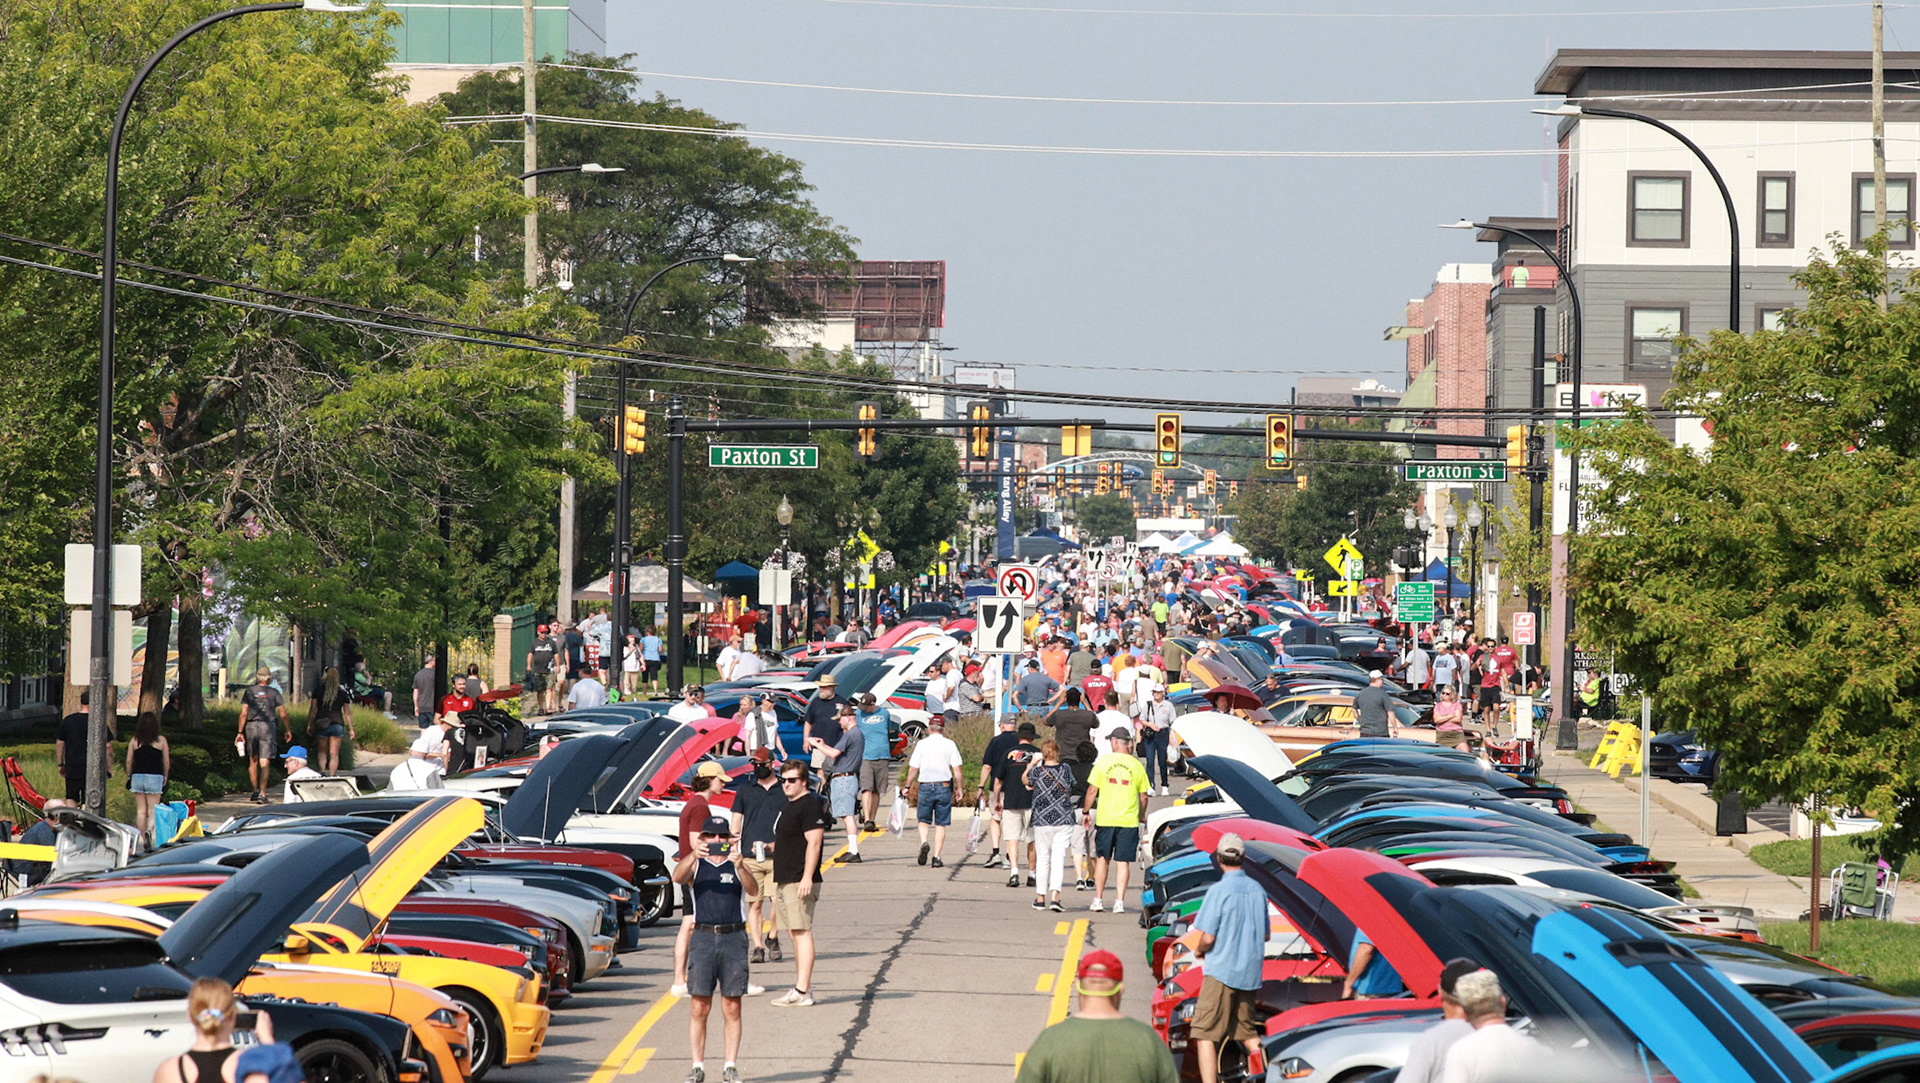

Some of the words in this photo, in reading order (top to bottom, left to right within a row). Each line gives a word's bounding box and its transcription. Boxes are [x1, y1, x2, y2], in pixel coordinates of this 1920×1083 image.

[721, 448, 781, 465] Paxton
[789, 448, 806, 465] St
[1001, 457, 1012, 498] Mutang
[1417, 464, 1472, 478] Paxton
[1479, 463, 1495, 478] St
[1001, 499, 1012, 523] Alley
